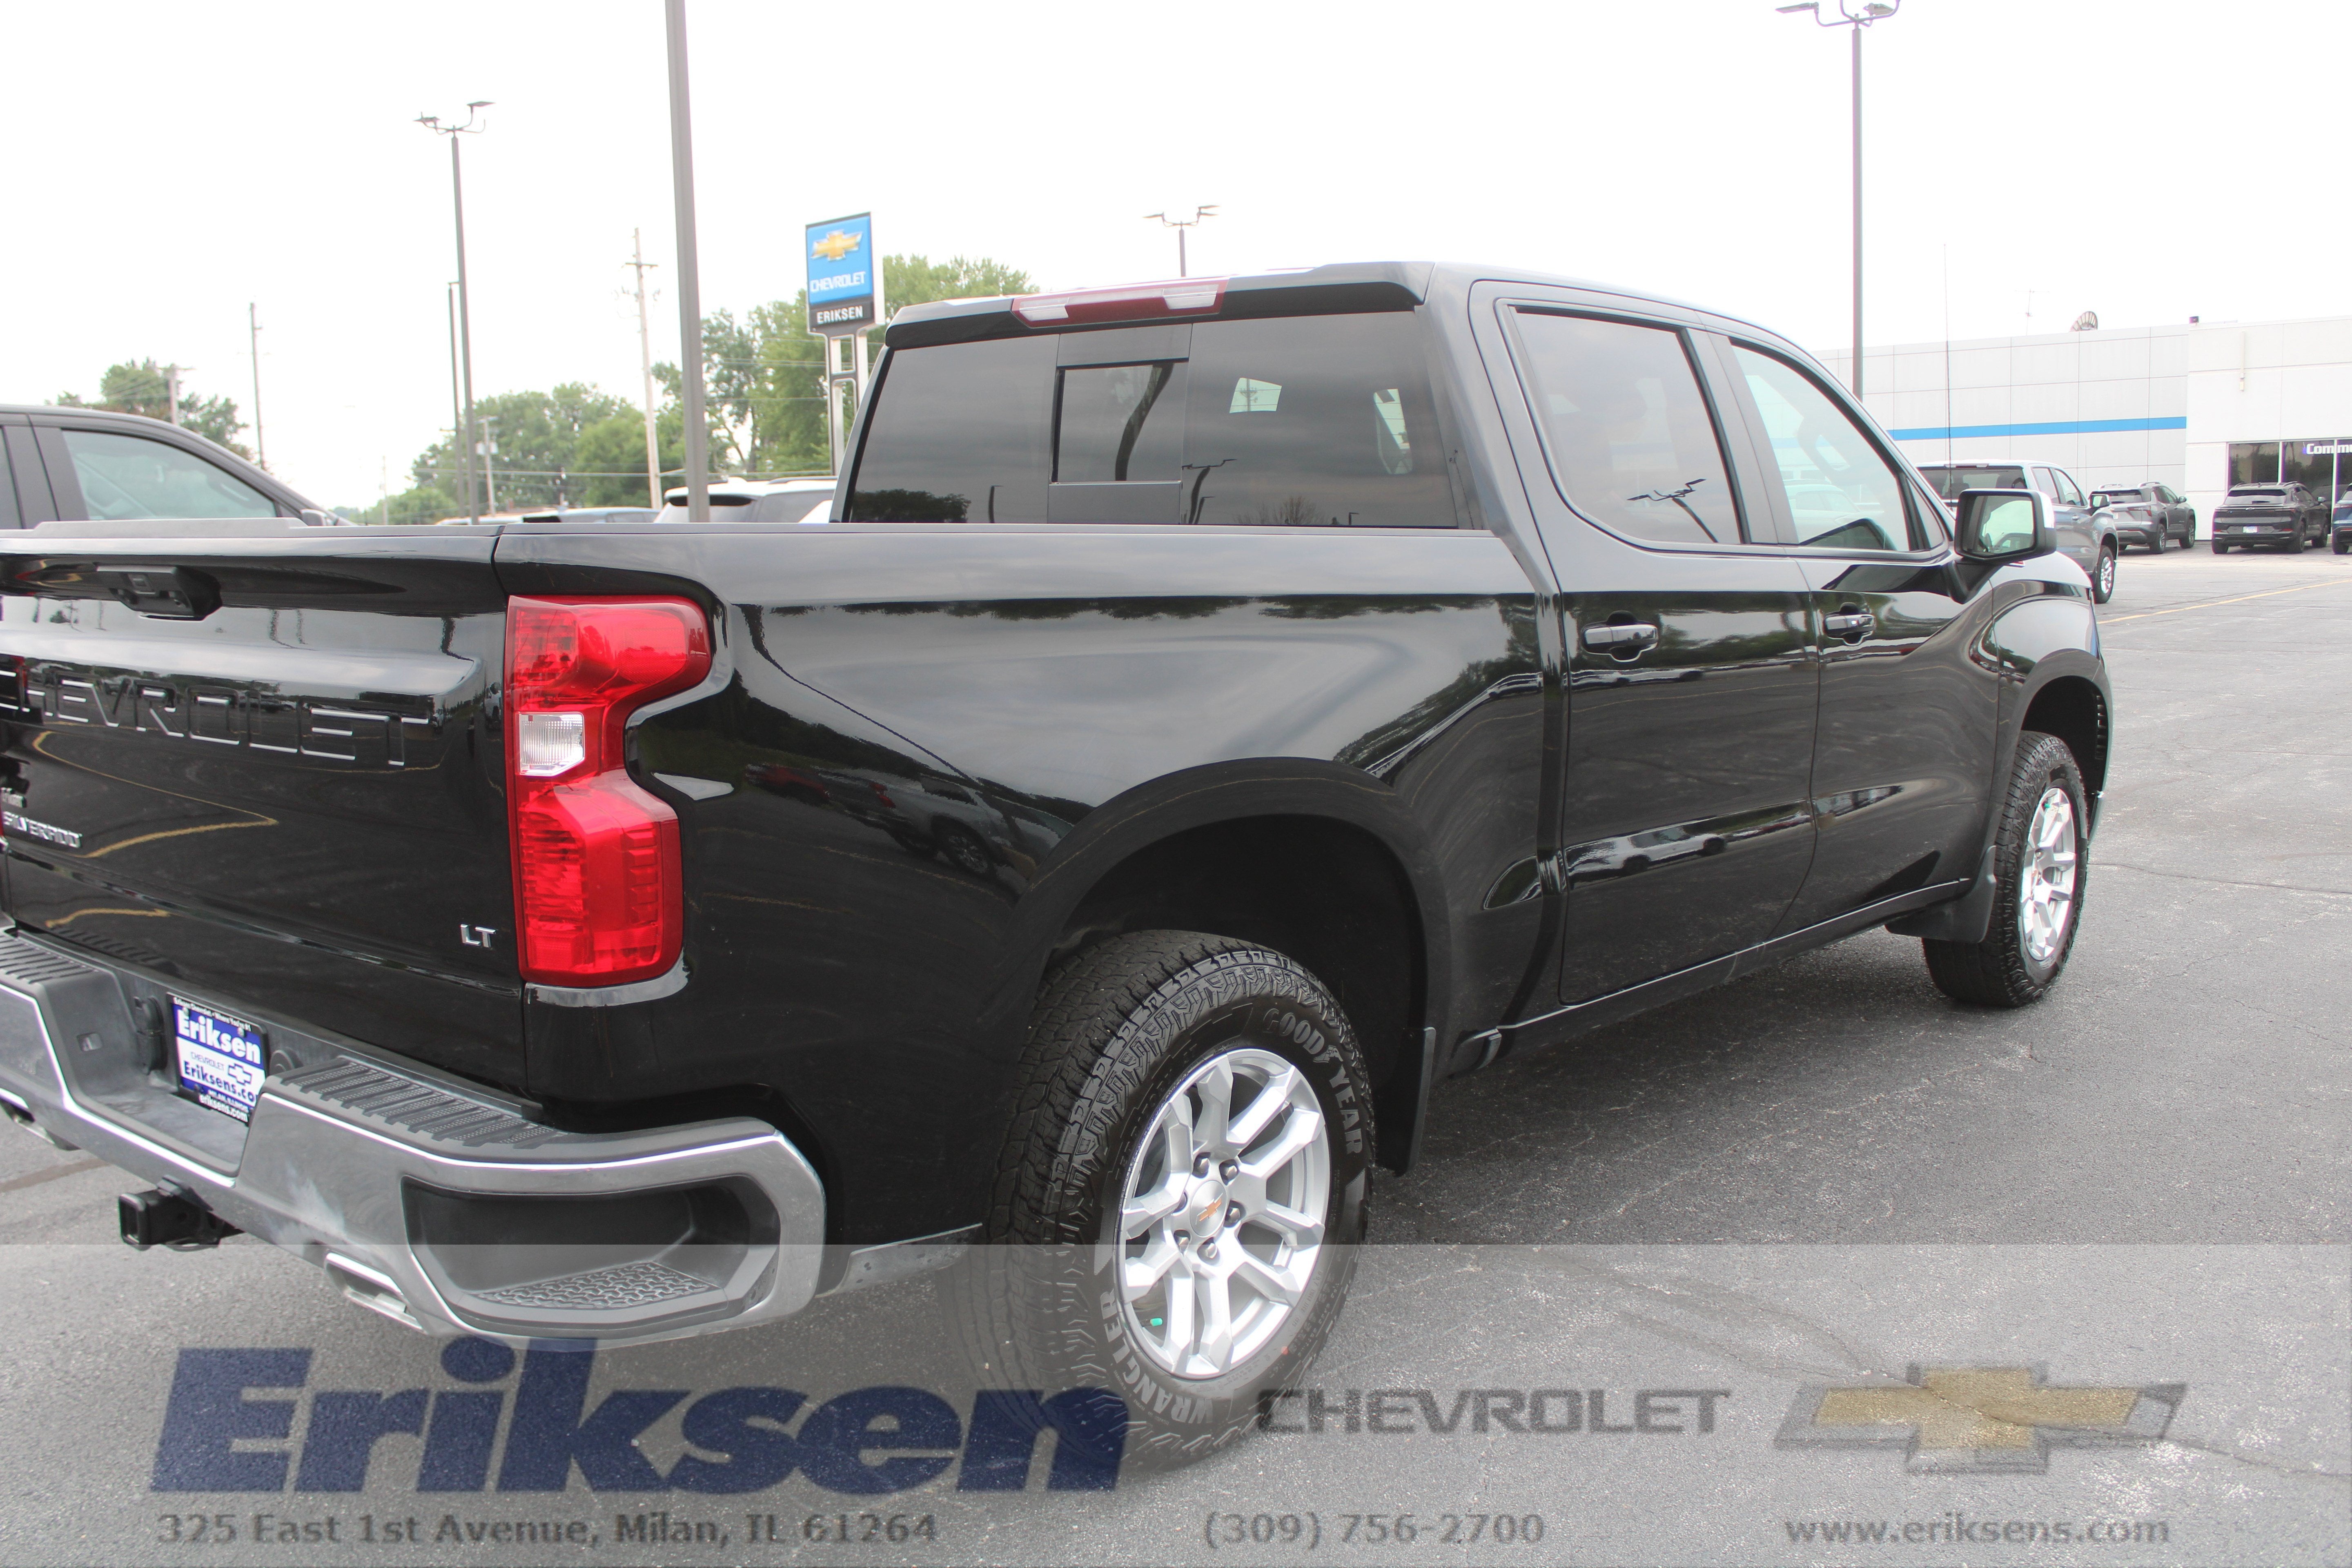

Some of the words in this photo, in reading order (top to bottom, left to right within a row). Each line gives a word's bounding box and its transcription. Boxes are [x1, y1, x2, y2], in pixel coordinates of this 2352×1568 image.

[810, 271, 866, 292] CHEVROLET
[817, 305, 863, 325] ERIKSEN
[460, 923, 496, 950] LT
[177, 1008, 261, 1065] Eriksen
[191, 1051, 225, 1071] CHEVROLET
[184, 1060, 259, 1102] Eriksens.co
[1100, 1287, 1214, 1424] WRANGLER
